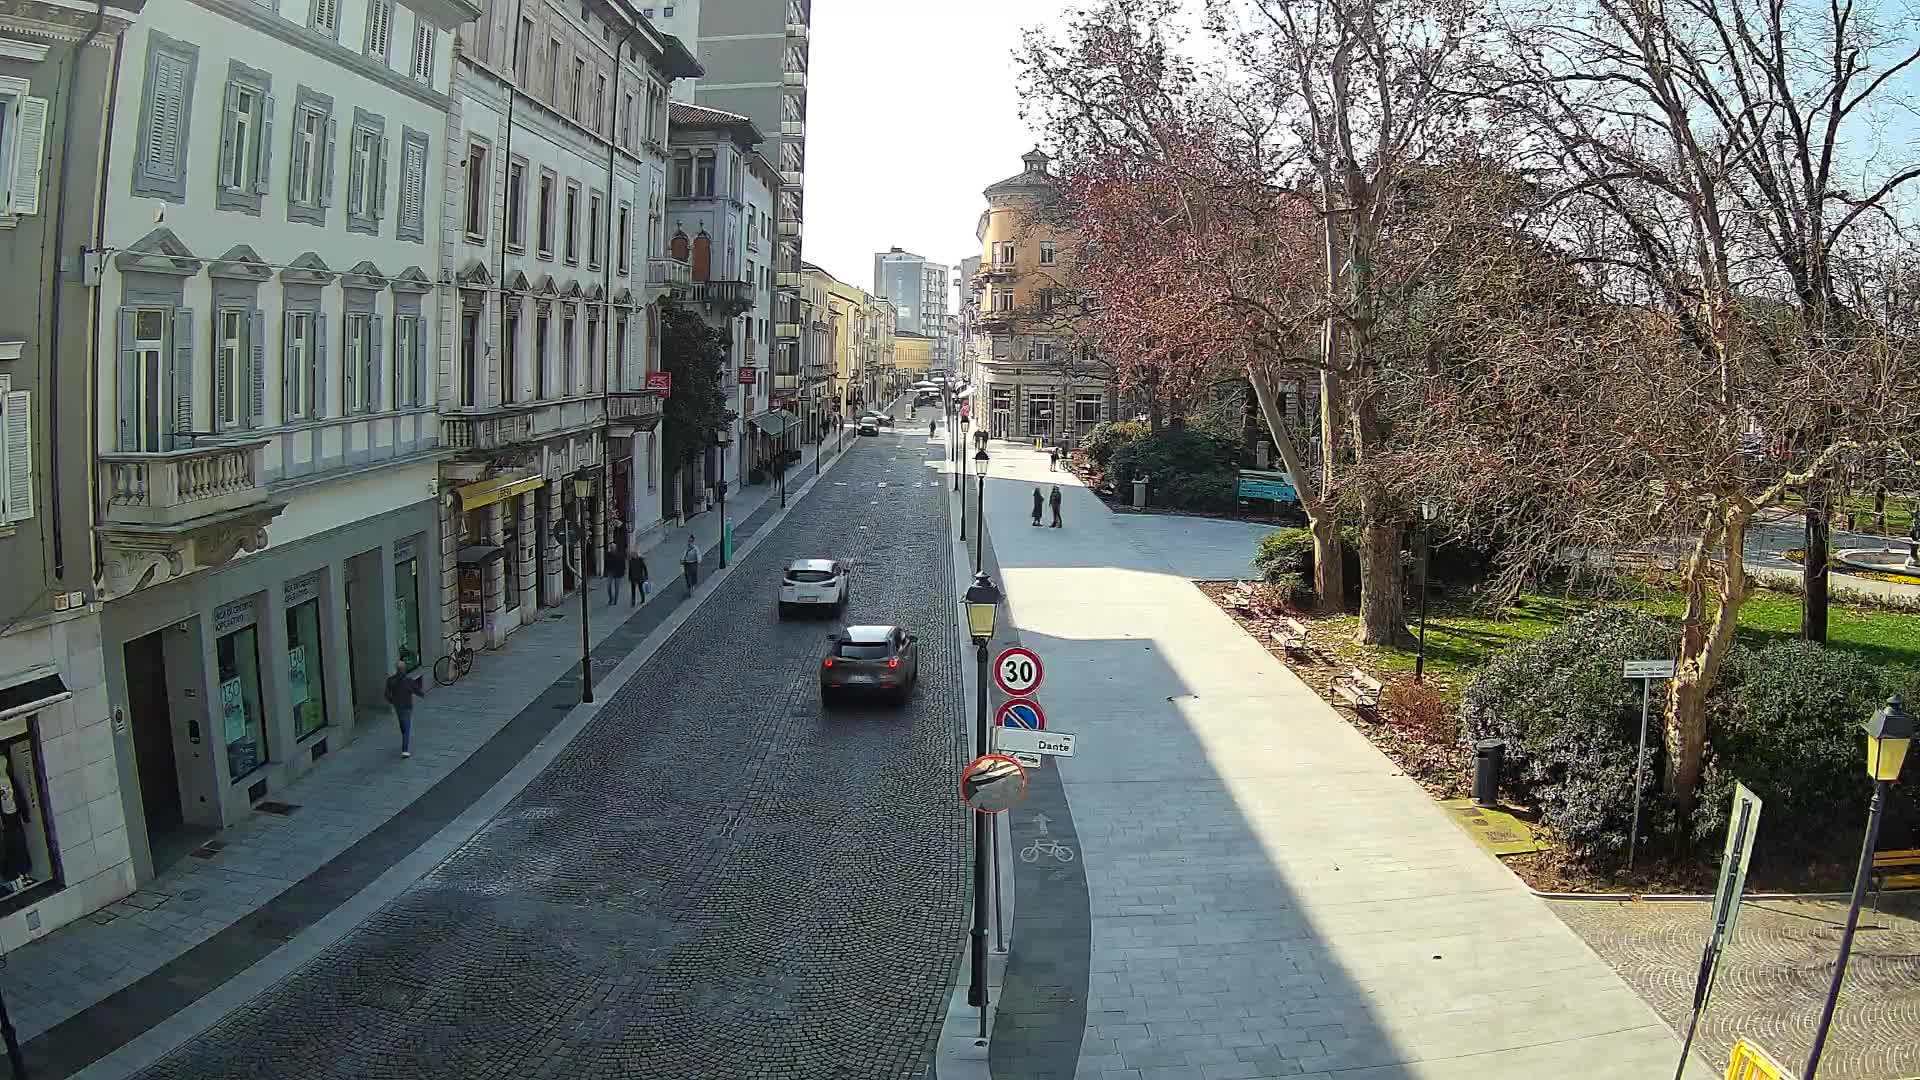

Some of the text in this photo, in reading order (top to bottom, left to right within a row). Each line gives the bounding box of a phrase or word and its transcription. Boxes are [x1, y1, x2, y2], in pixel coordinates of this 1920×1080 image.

[1005, 660, 1033, 683] 30
[222, 680, 240, 702] 130
[1038, 740, 1070, 751] Dante
